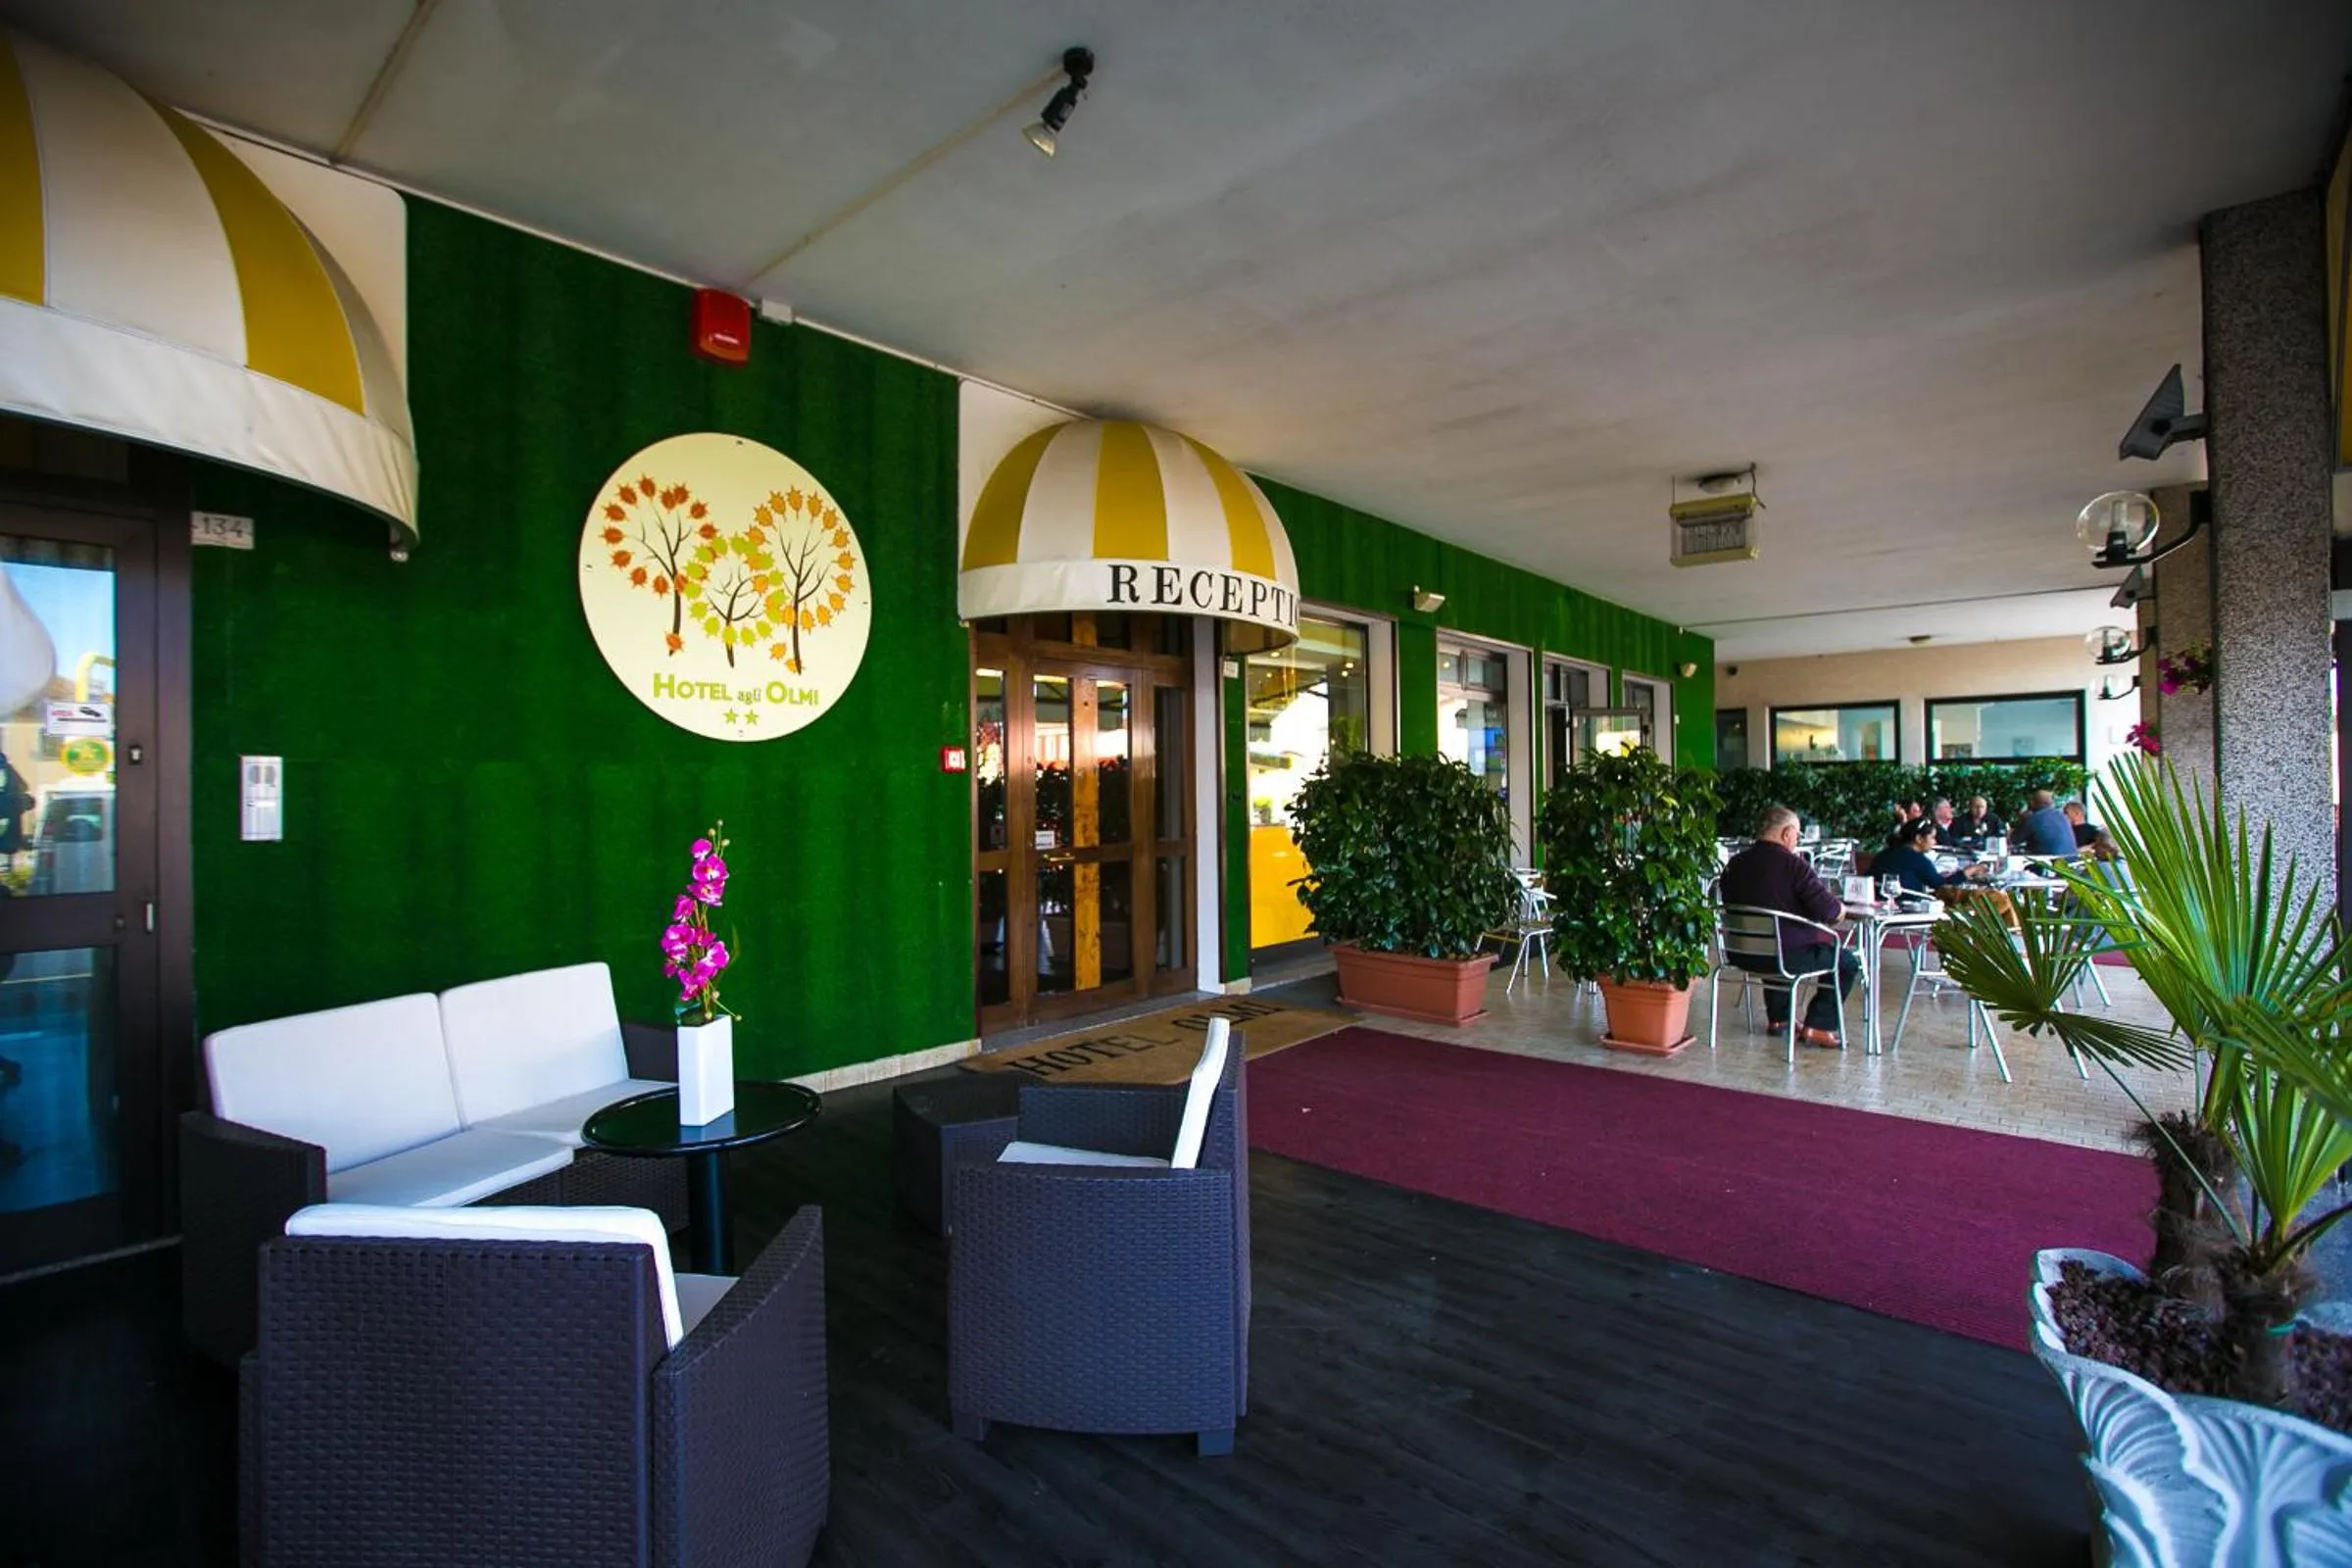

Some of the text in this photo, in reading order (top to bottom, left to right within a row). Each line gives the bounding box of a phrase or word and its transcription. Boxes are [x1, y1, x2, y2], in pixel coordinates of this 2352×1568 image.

[202, 515, 243, 538] 134
[1106, 564, 1298, 627] RECEPTI
[653, 672, 819, 706] HOTEL agli OLMI
[1002, 1034, 1182, 1076] HOTEL
